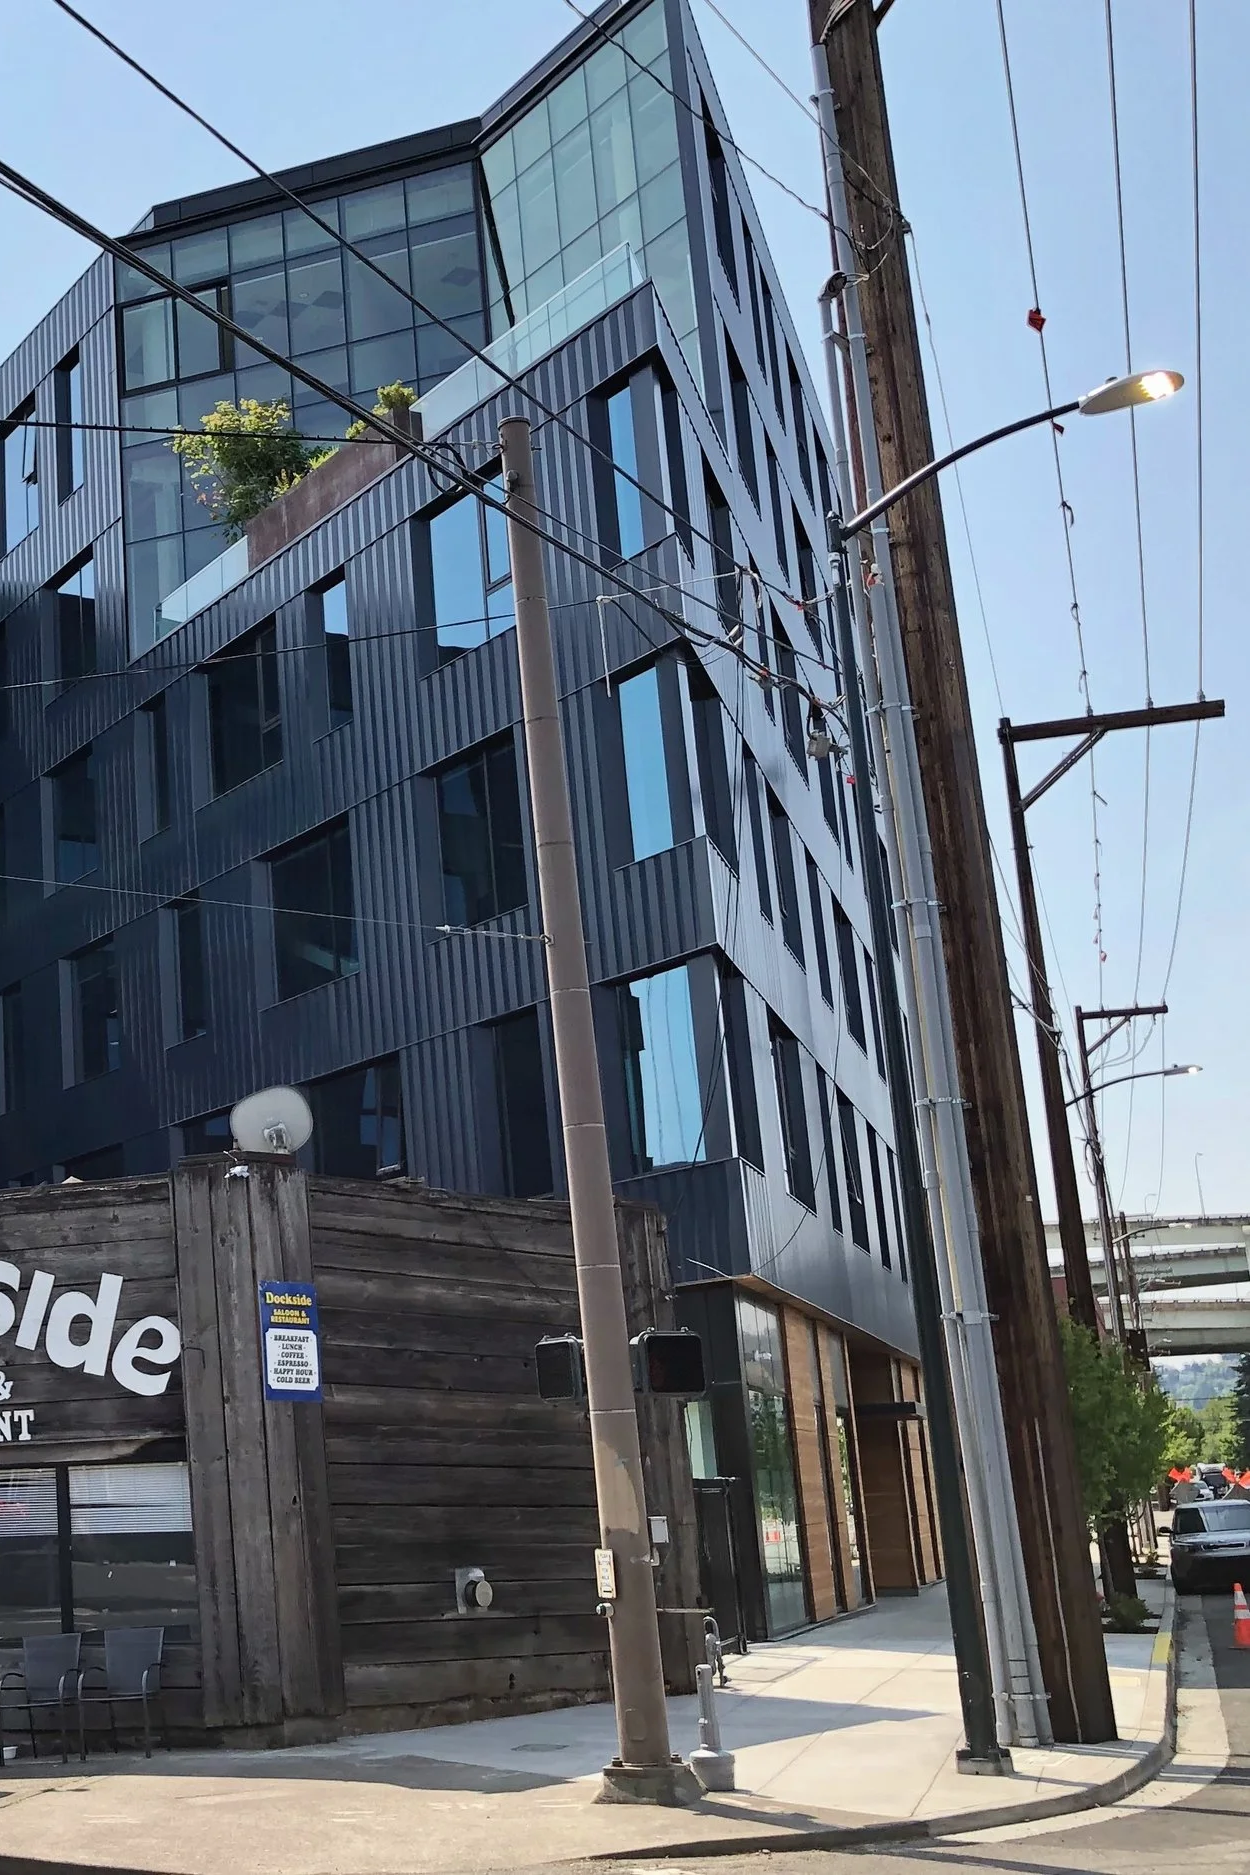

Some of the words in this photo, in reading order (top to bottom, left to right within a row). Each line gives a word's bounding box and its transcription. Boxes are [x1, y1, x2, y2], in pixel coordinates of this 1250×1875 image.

[265, 1292, 312, 1306] Dockside
[273, 1308, 299, 1317] SALOON
[270, 1315, 310, 1325] RESTAURANT
[273, 1334, 309, 1343] BREAKFAST
[281, 1343, 303, 1351] LUNCH
[280, 1351, 305, 1359] COFFEE
[277, 1359, 309, 1368] ESPRESSO
[273, 1367, 294, 1375] HAPPY
[295, 1368, 313, 1376] HOUR
[276, 1376, 293, 1384] COLD
